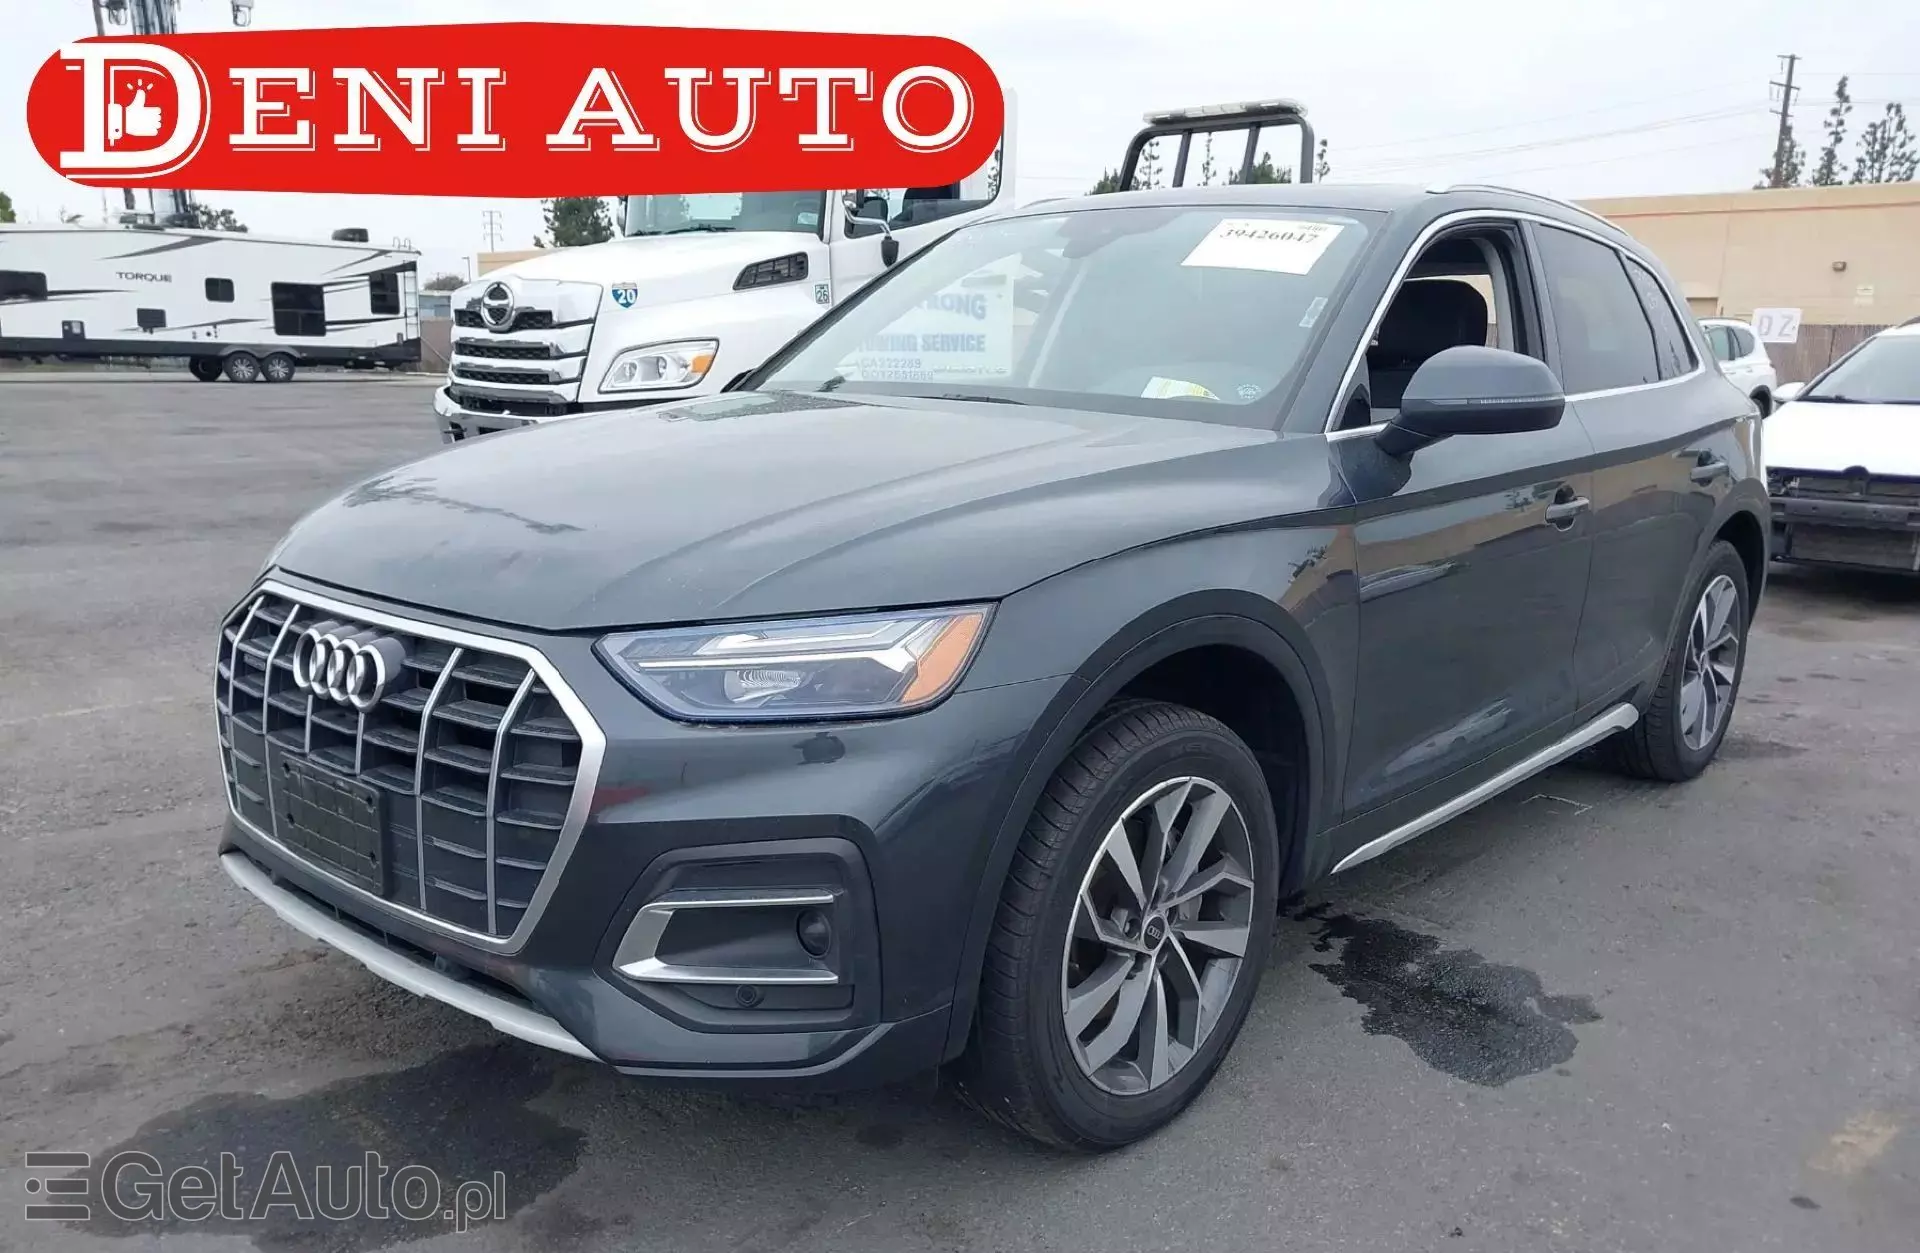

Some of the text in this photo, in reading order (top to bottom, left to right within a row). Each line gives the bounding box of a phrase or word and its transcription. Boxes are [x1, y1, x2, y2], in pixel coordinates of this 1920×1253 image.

[115, 271, 173, 283] TORQUE
[617, 289, 637, 304] 20
[921, 333, 986, 353] SERVICE
